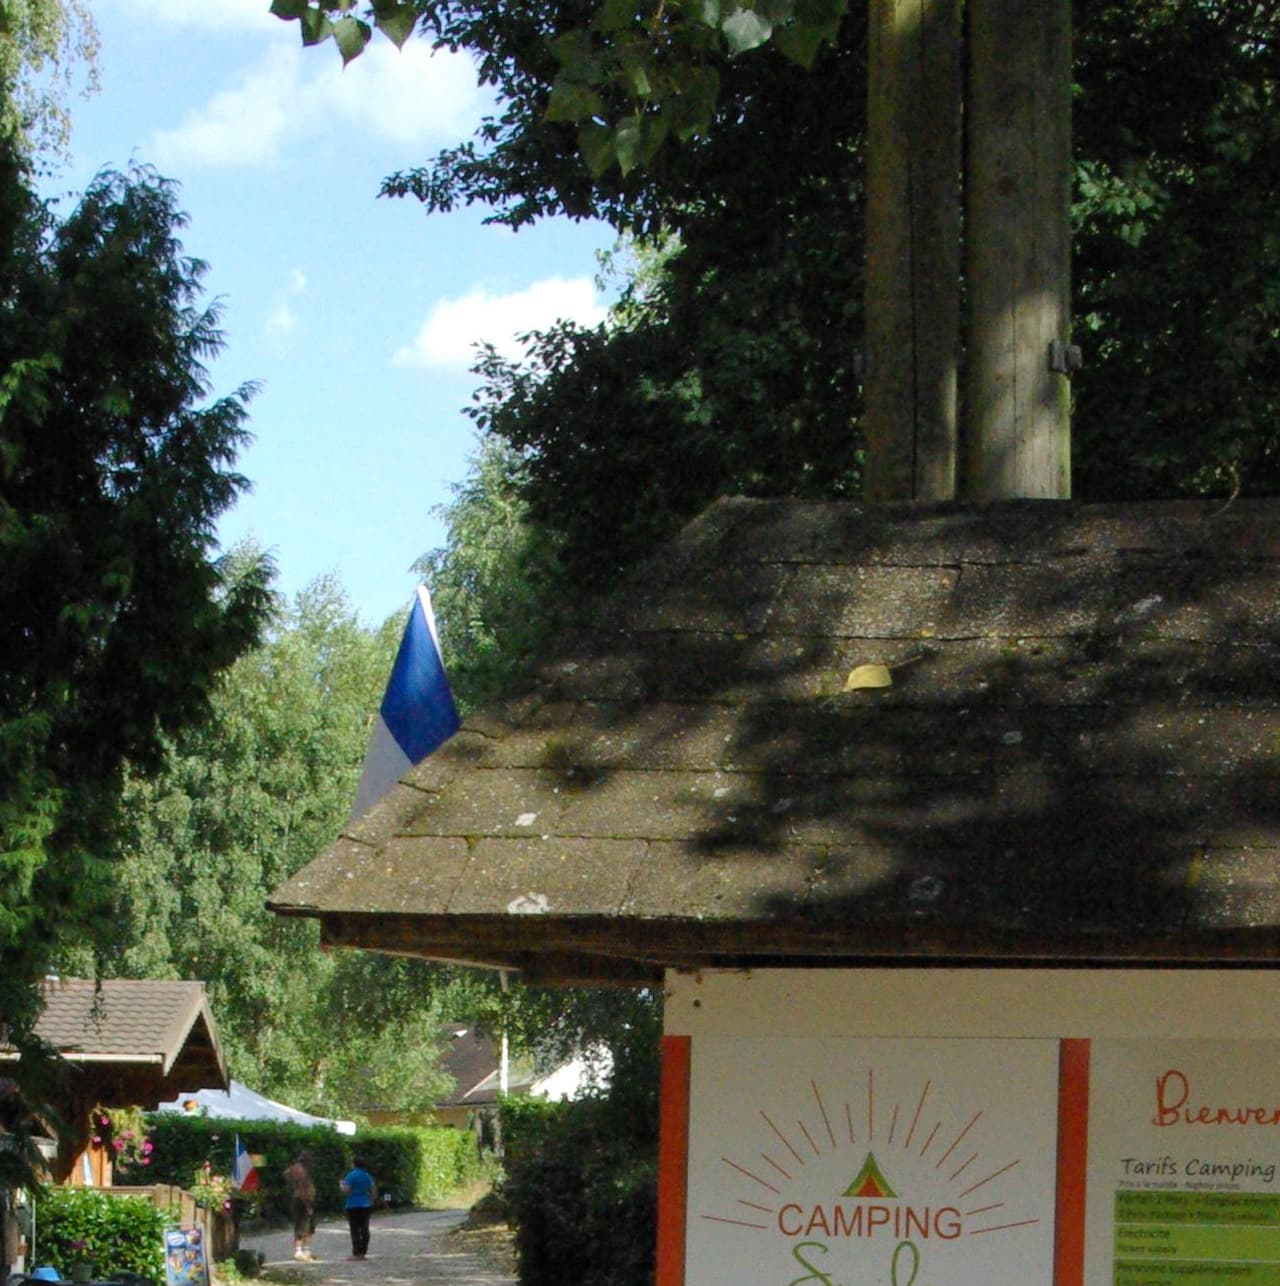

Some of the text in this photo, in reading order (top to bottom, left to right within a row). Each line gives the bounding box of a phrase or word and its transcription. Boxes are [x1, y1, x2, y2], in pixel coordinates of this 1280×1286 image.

[1120, 1155, 1178, 1177] Tarifs
[1184, 1157, 1277, 1184] Camping
[777, 1203, 962, 1240] CAMPING
